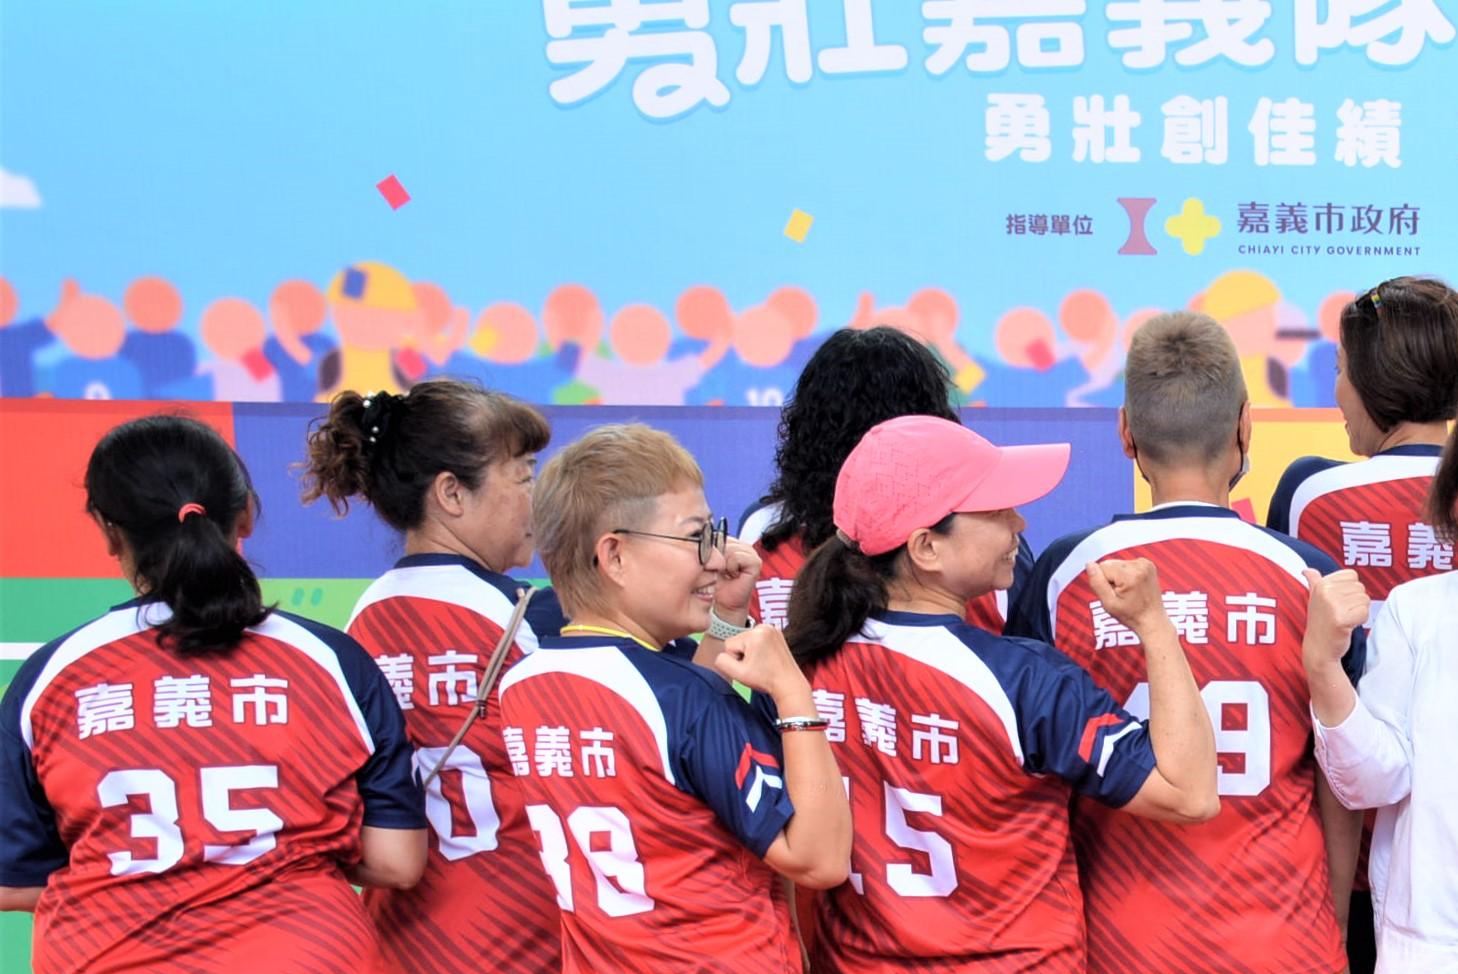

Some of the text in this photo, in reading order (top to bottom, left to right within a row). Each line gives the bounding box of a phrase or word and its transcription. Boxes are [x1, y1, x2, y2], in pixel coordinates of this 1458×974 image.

[984, 93, 1403, 168] 勇壯創佳績
[1006, 213, 1094, 236] 指導單位
[1237, 201, 1421, 236] 嘉義市政府
[1238, 244, 1421, 257] CHIAYI CITY GOVERNMENT
[74, 673, 289, 740] 嘉義市
[97, 764, 284, 876] 35
[843, 776, 959, 897] 5
